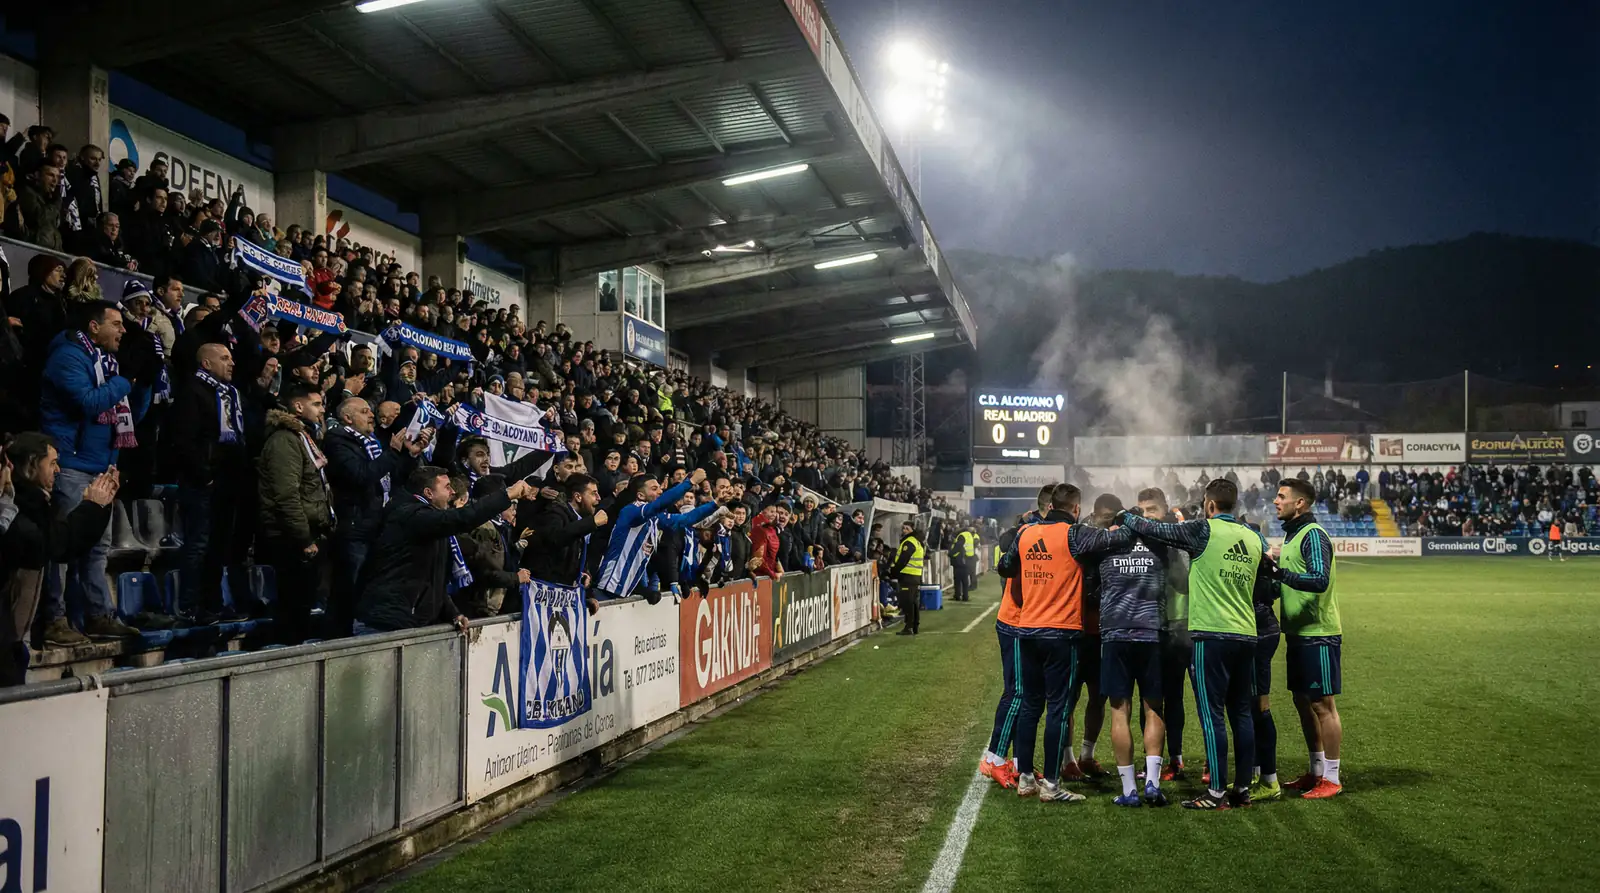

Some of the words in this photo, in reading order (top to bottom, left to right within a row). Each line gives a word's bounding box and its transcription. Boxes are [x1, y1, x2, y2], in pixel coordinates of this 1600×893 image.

[1001, 395, 1054, 408] ALCOYANO
[984, 409, 1012, 421] REAL
[1014, 410, 1057, 422] MADRID
[503, 424, 538, 444] ACOYANO
[992, 423, 1006, 444] 0
[1037, 425, 1050, 445] 0
[1112, 556, 1154, 567] Emirates
